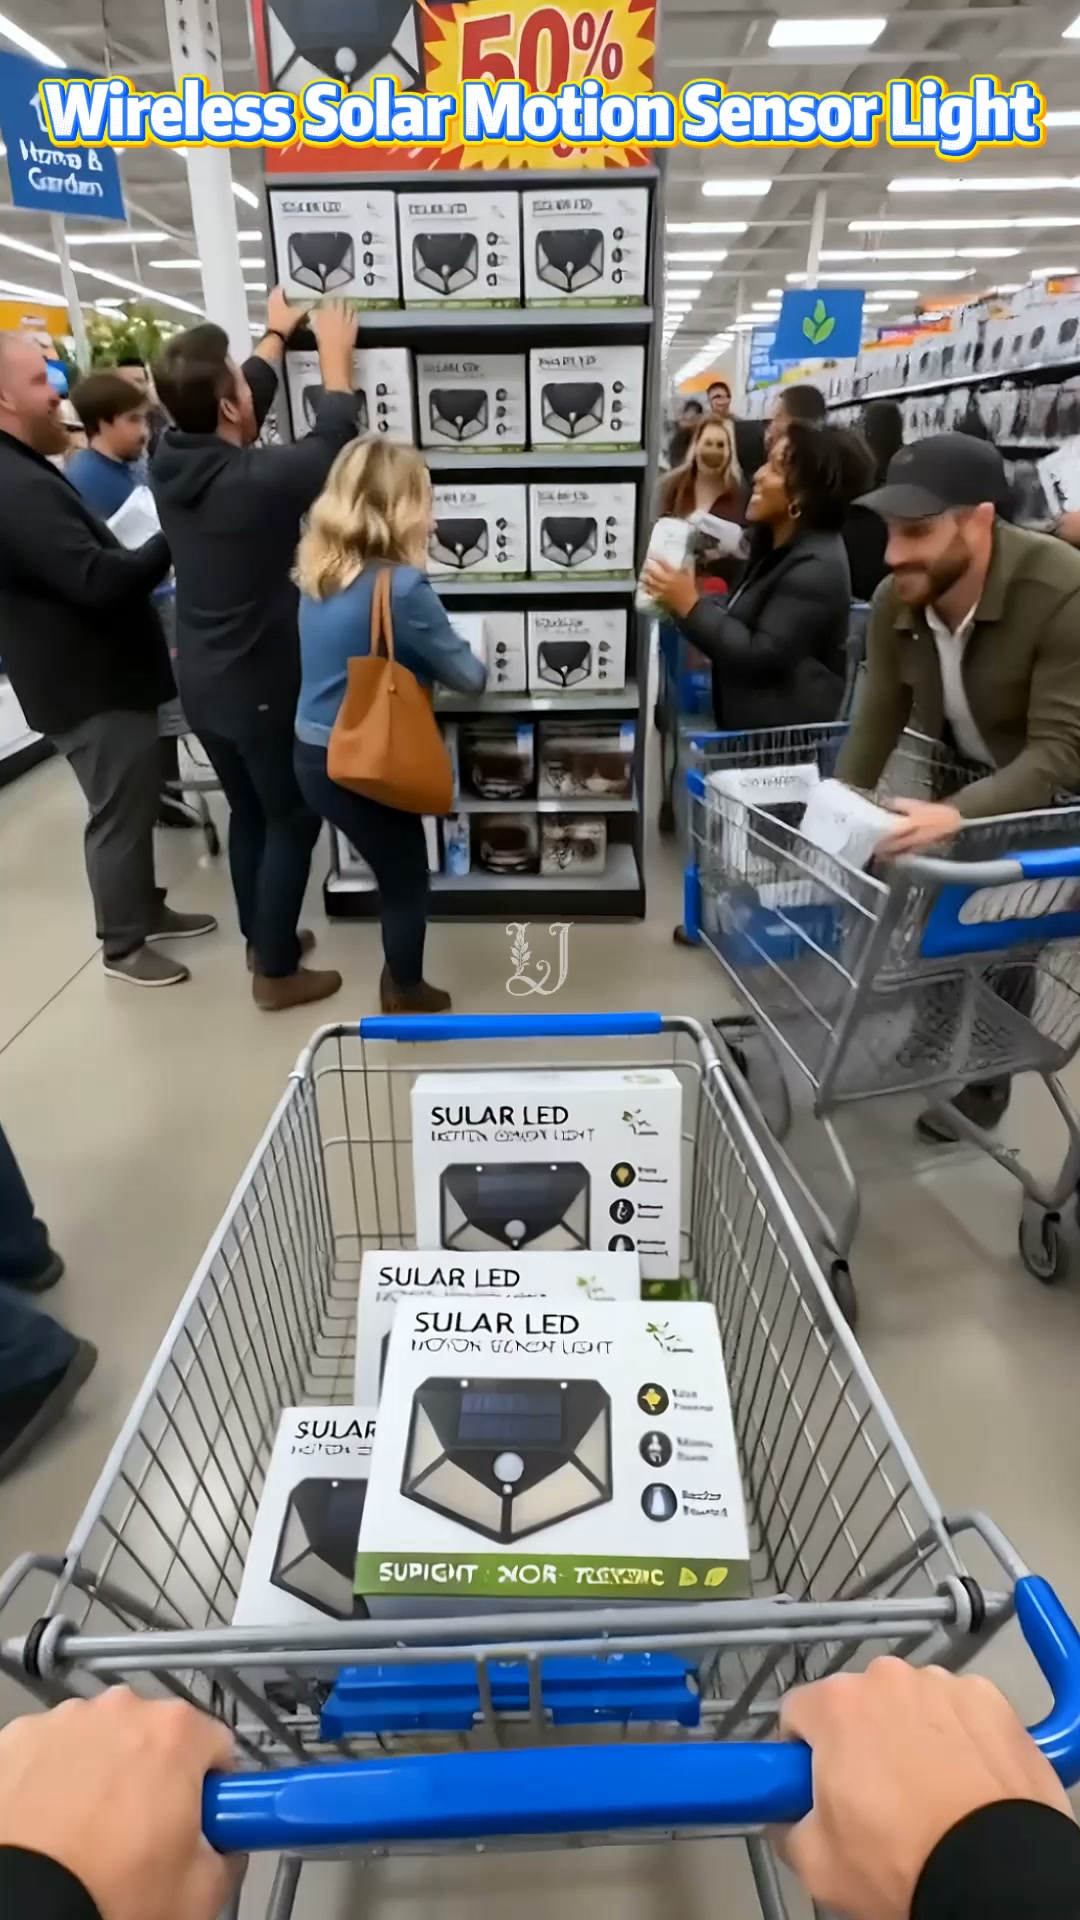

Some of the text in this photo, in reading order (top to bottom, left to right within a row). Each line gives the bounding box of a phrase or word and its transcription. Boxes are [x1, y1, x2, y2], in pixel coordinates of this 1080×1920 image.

[431, 1105, 569, 1126] SULAR LED
[378, 1266, 520, 1288] SULAR LED
[414, 1311, 580, 1335] SULAR LED
